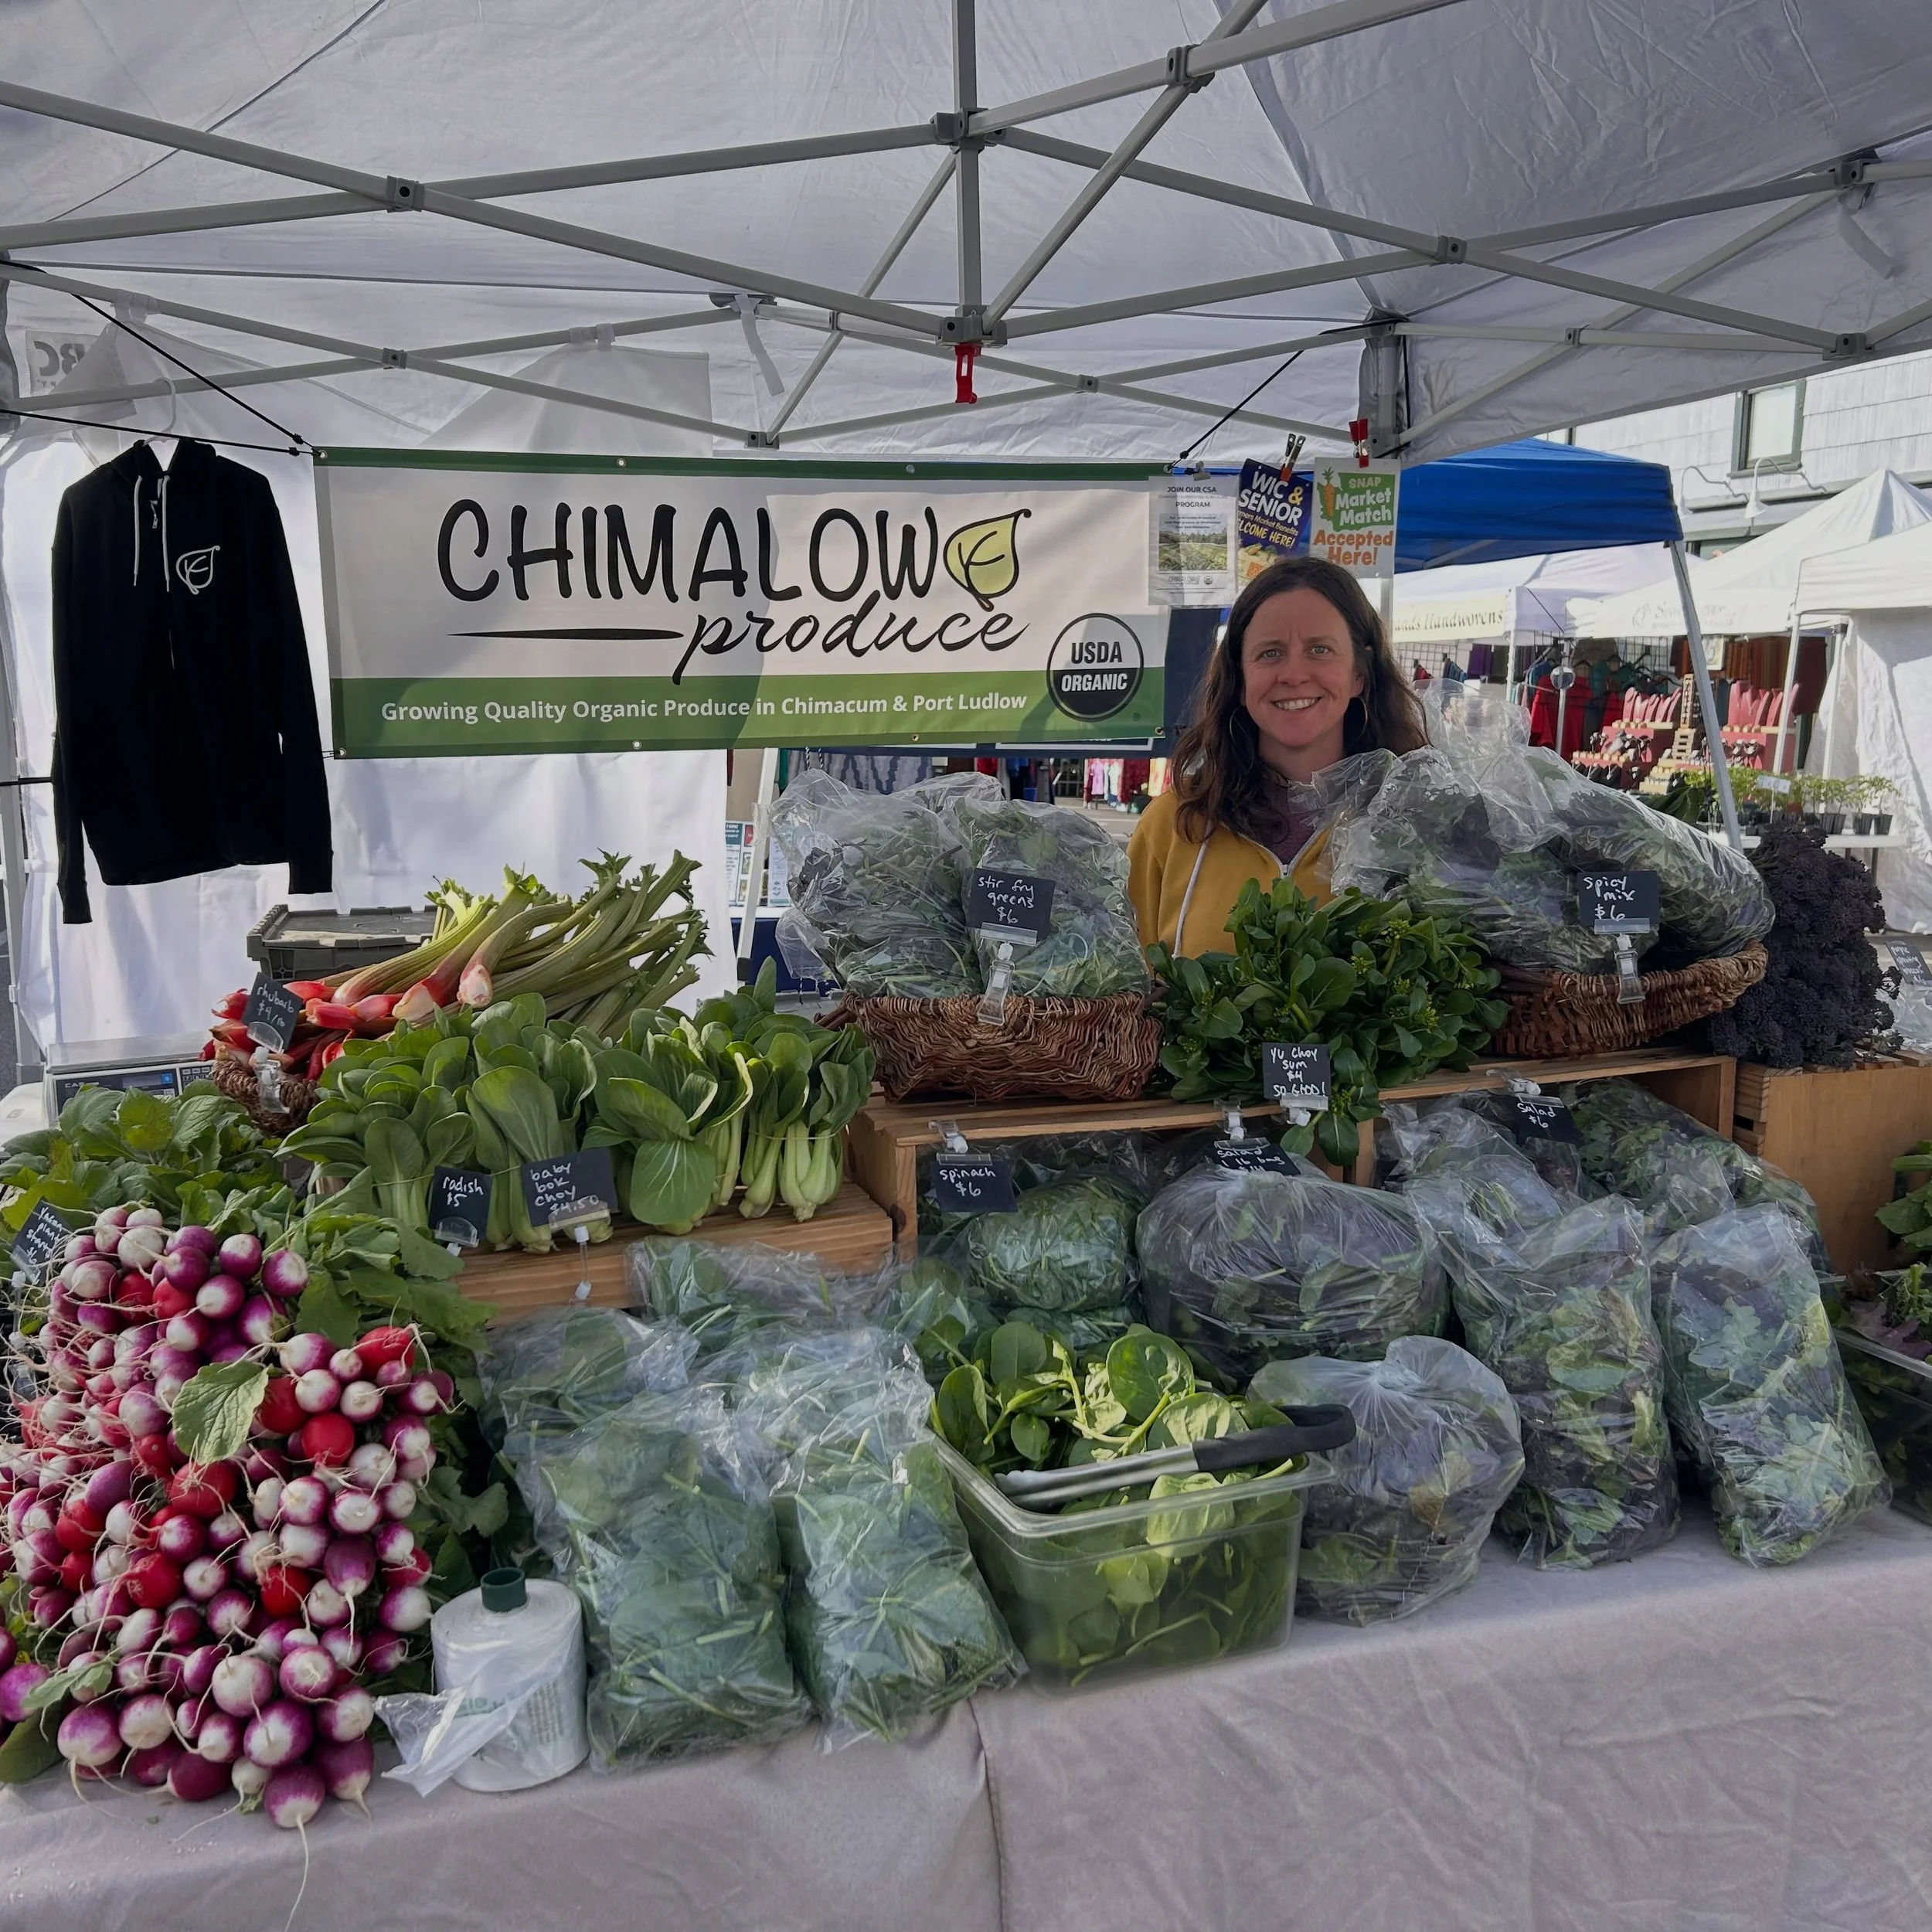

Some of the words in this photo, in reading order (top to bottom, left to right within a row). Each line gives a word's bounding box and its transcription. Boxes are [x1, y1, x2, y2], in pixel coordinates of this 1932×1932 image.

[1252, 471, 1288, 499] WIC
[1287, 486, 1304, 505] &
[1349, 477, 1382, 488] SNAP
[1237, 488, 1303, 526] SENIOR
[1335, 488, 1392, 510] Market
[1339, 505, 1392, 526] Match
[1268, 530, 1296, 549] HERE!
[1313, 529, 1393, 550] Accepted
[437, 498, 938, 603] CHIMALOW
[1328, 546, 1378, 566] Here!
[672, 589, 1029, 685] produce
[1071, 641, 1123, 665] USDA
[1061, 672, 1128, 692] ORGANIC
[381, 701, 479, 725] Growing
[484, 700, 566, 723] Quality
[573, 699, 658, 723] Organic
[664, 698, 750, 716] Produce
[756, 697, 775, 715] in
[781, 696, 888, 714] Chimacum
[893, 696, 908, 713] &
[913, 695, 954, 712] Port
[958, 692, 1028, 711] Ludlow
[978, 875, 1005, 889] stir
[1012, 879, 1035, 900] fry
[1604, 889, 1636, 901] mix
[987, 892, 1034, 909] greens
[996, 906, 1019, 924] $6
[256, 983, 294, 1013] rhubarb
[1286, 1070, 1304, 1083] $4
[1528, 1114, 1549, 1128] $6
[530, 1162, 572, 1182] baby
[939, 1167, 996, 1184] spinach
[442, 1175, 484, 1196] radish
[536, 1176, 570, 1193] bok
[955, 1180, 981, 1197] $6
[447, 1192, 468, 1207] $5
[549, 1194, 599, 1216] $4.50
